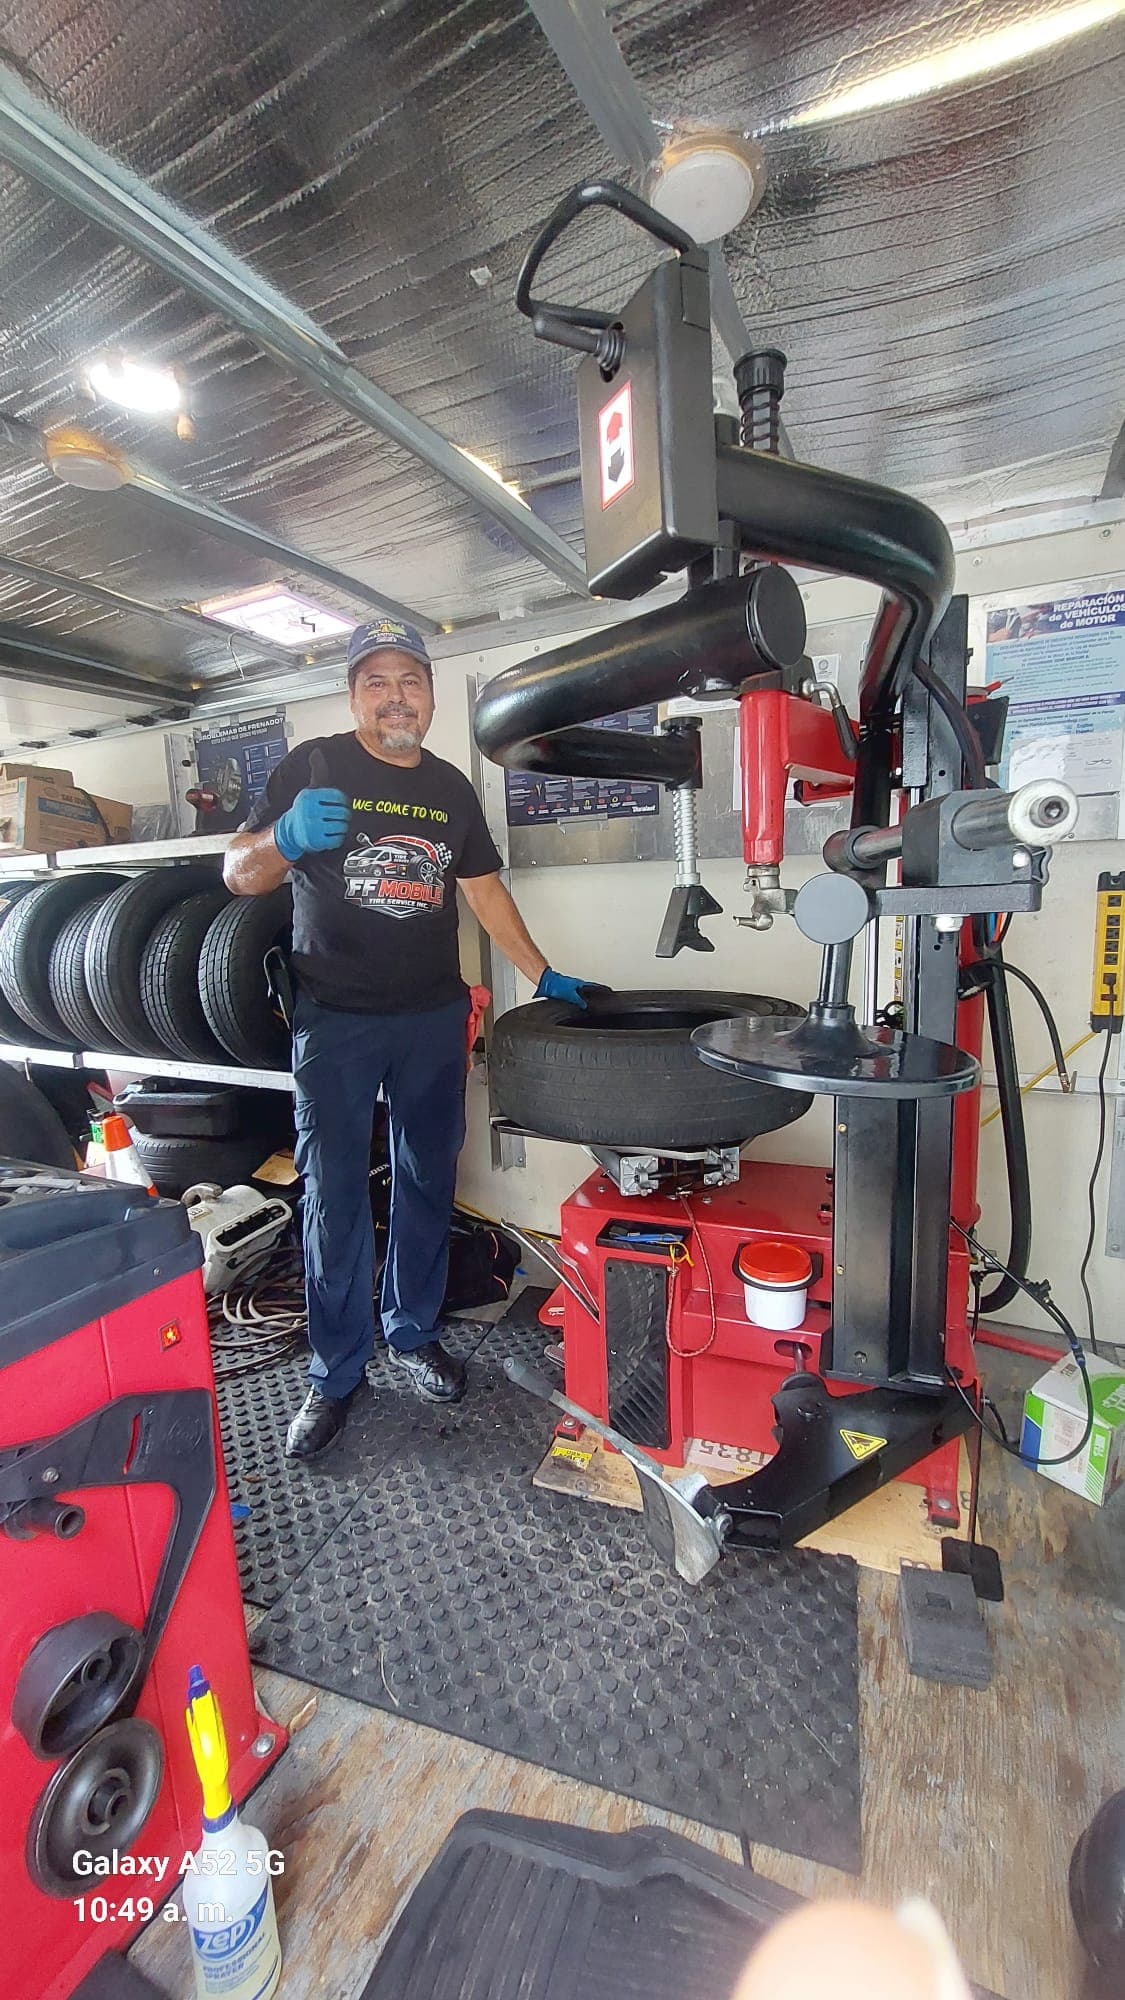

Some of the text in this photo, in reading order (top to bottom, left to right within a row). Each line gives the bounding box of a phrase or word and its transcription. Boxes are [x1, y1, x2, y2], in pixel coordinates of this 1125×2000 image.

[1053, 594, 1124, 612] REPARACIÓN
[1049, 604, 1125, 622] de VEHÍCULOS
[1060, 614, 1116, 629] de MOTOR
[352, 798, 448, 824] WE COME TO YOU
[347, 879, 443, 905] FF MOBILE
[386, 898, 416, 907] SERVICE
